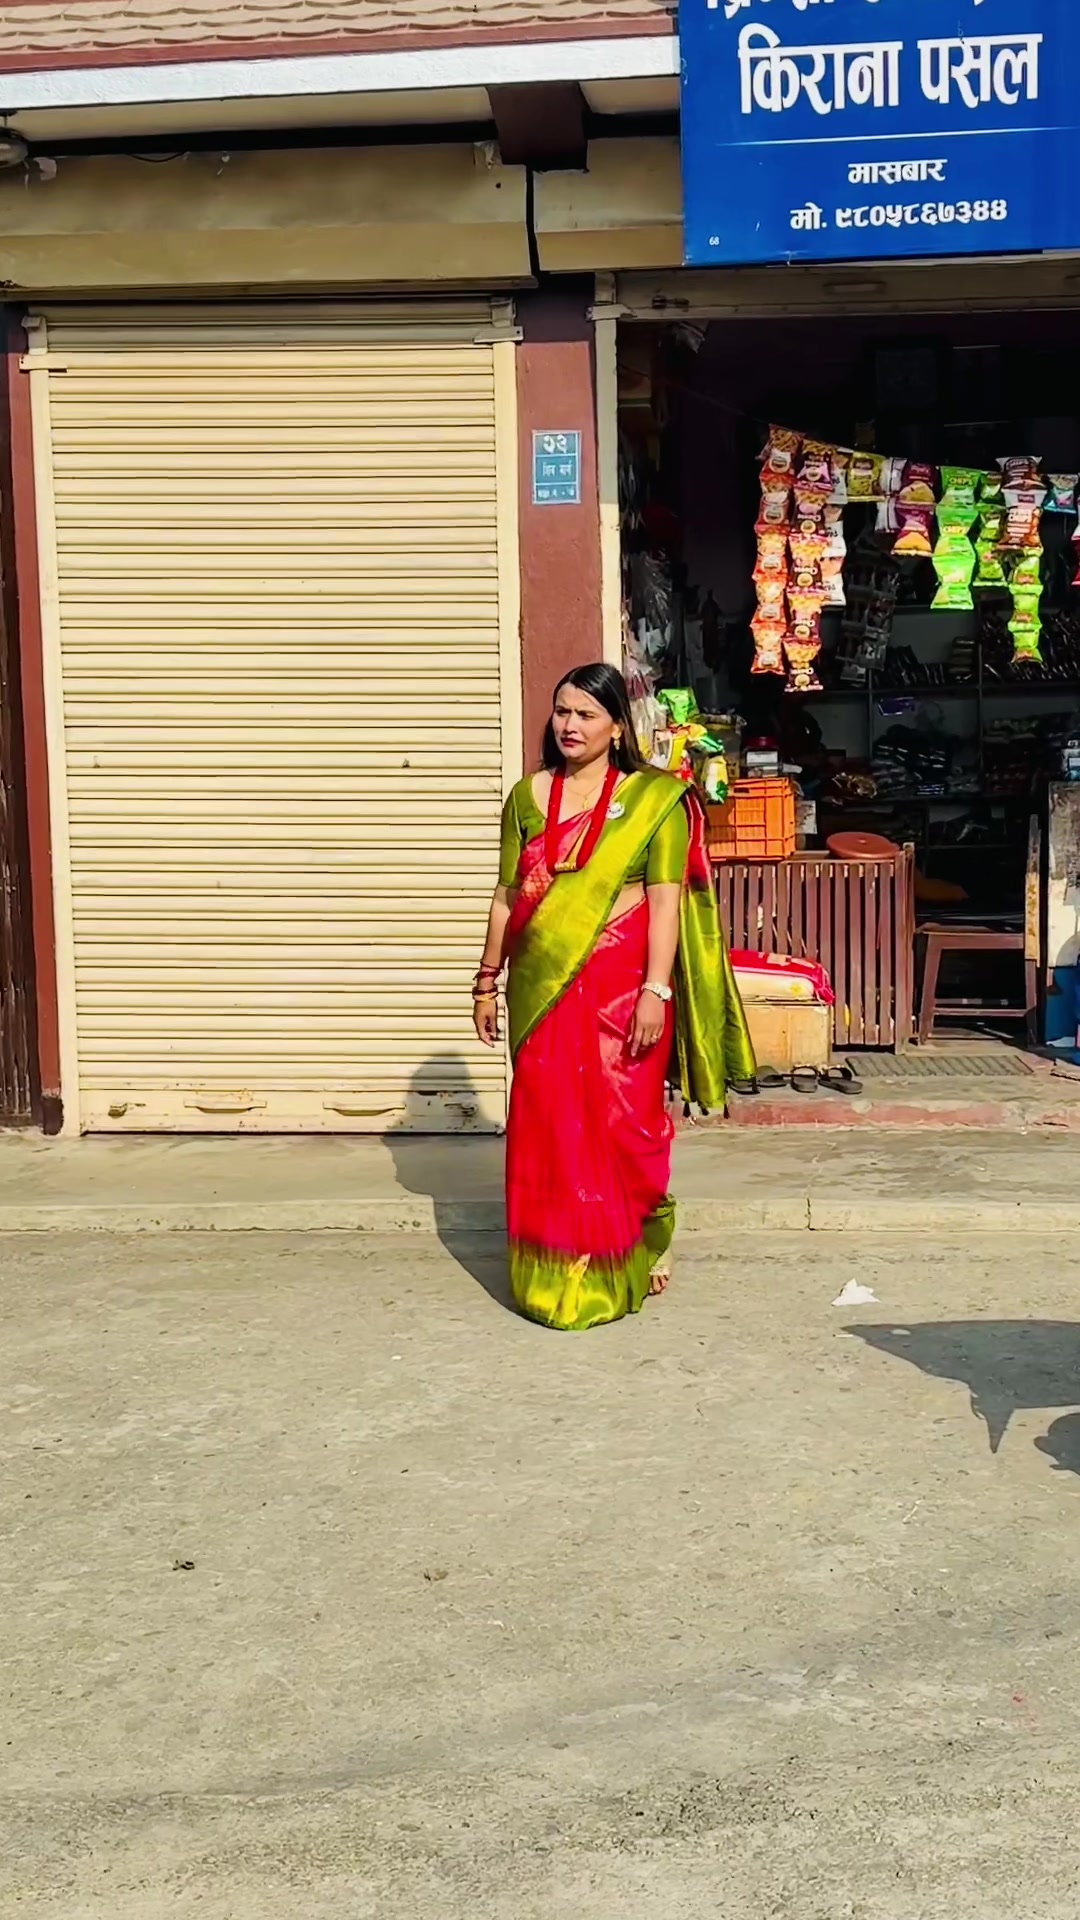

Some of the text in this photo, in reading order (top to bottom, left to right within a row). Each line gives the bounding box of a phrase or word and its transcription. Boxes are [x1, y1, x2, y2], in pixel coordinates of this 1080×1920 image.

[738, 23, 1043, 114] किराना पसल
[847, 158, 948, 185] मासबार
[790, 202, 828, 230] मो.
[708, 236, 720, 246] 68
